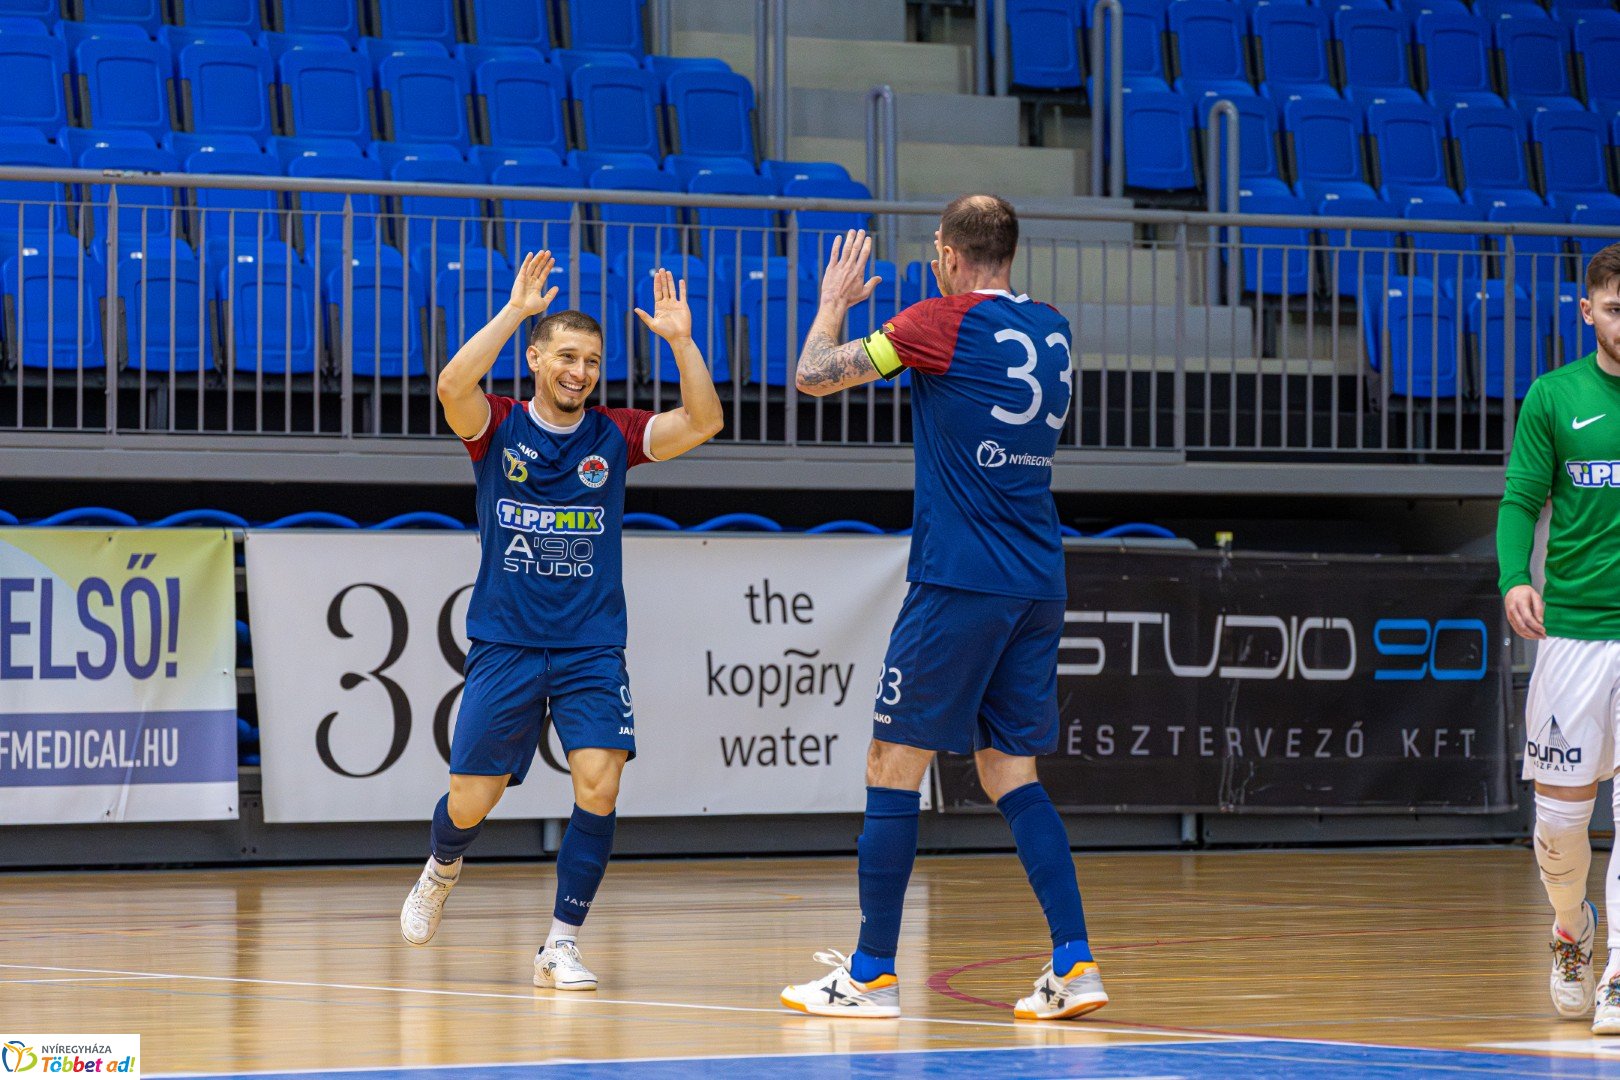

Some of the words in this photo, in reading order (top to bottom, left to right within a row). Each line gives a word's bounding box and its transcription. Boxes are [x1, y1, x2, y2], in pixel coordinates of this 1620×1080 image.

[990, 328, 1073, 430] 33
[517, 442, 538, 460] JAKO
[503, 557, 594, 577] STUDIO
[0, 553, 181, 681] ELSŐ!
[744, 578, 814, 625] the
[1373, 618, 1488, 681] 90
[720, 726, 839, 768] water
[1066, 718, 1365, 760] ÉSZTERVEZŐ
[1401, 728, 1477, 758] KFT
